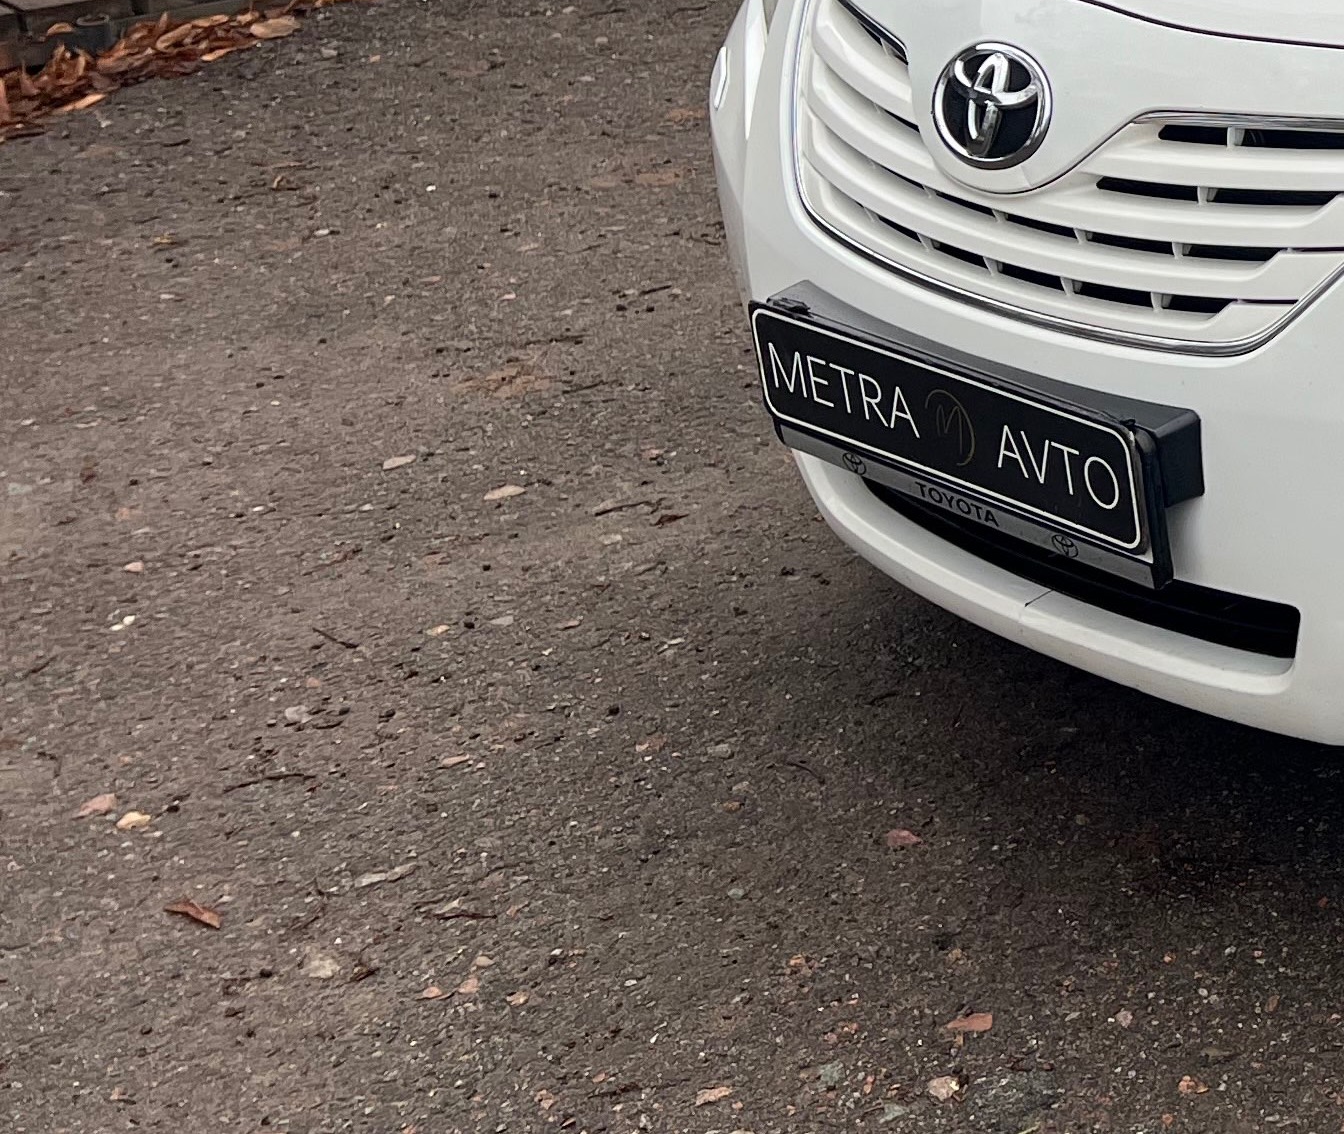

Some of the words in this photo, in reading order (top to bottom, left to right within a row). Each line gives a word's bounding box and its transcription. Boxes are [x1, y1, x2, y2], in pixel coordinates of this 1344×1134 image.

[767, 342, 921, 439] METRA
[997, 423, 1121, 511] AVTO
[915, 480, 1000, 528] TOYOTA
